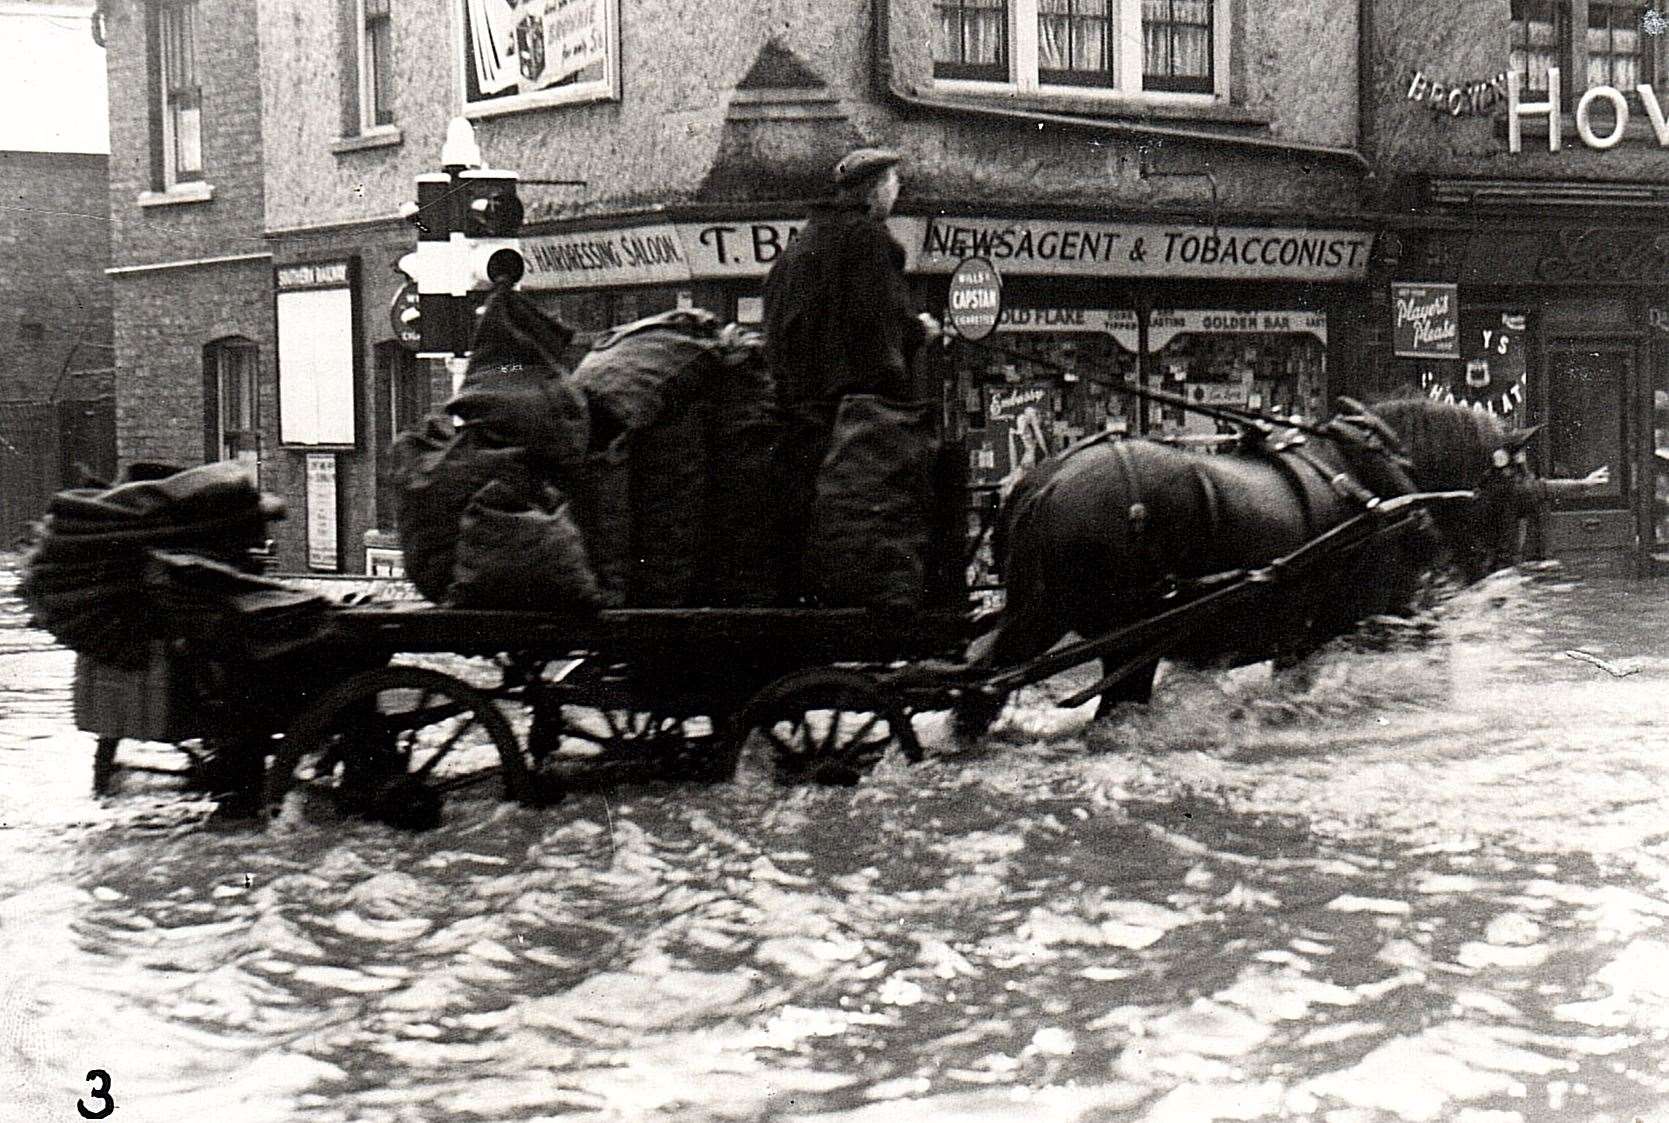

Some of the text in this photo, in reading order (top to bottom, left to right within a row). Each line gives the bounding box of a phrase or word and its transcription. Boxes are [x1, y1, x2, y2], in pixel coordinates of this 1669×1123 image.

[700, 226, 740, 264] T.
[922, 217, 1121, 262] NEWSAGENT
[1129, 237, 1148, 262] &
[953, 289, 997, 310] CAPSTAN
[1396, 295, 1449, 328] Player's
[1034, 309, 1085, 325] FLAKE
[1203, 316, 1290, 330] GOLDEN BAR
[1412, 319, 1456, 349] Please
